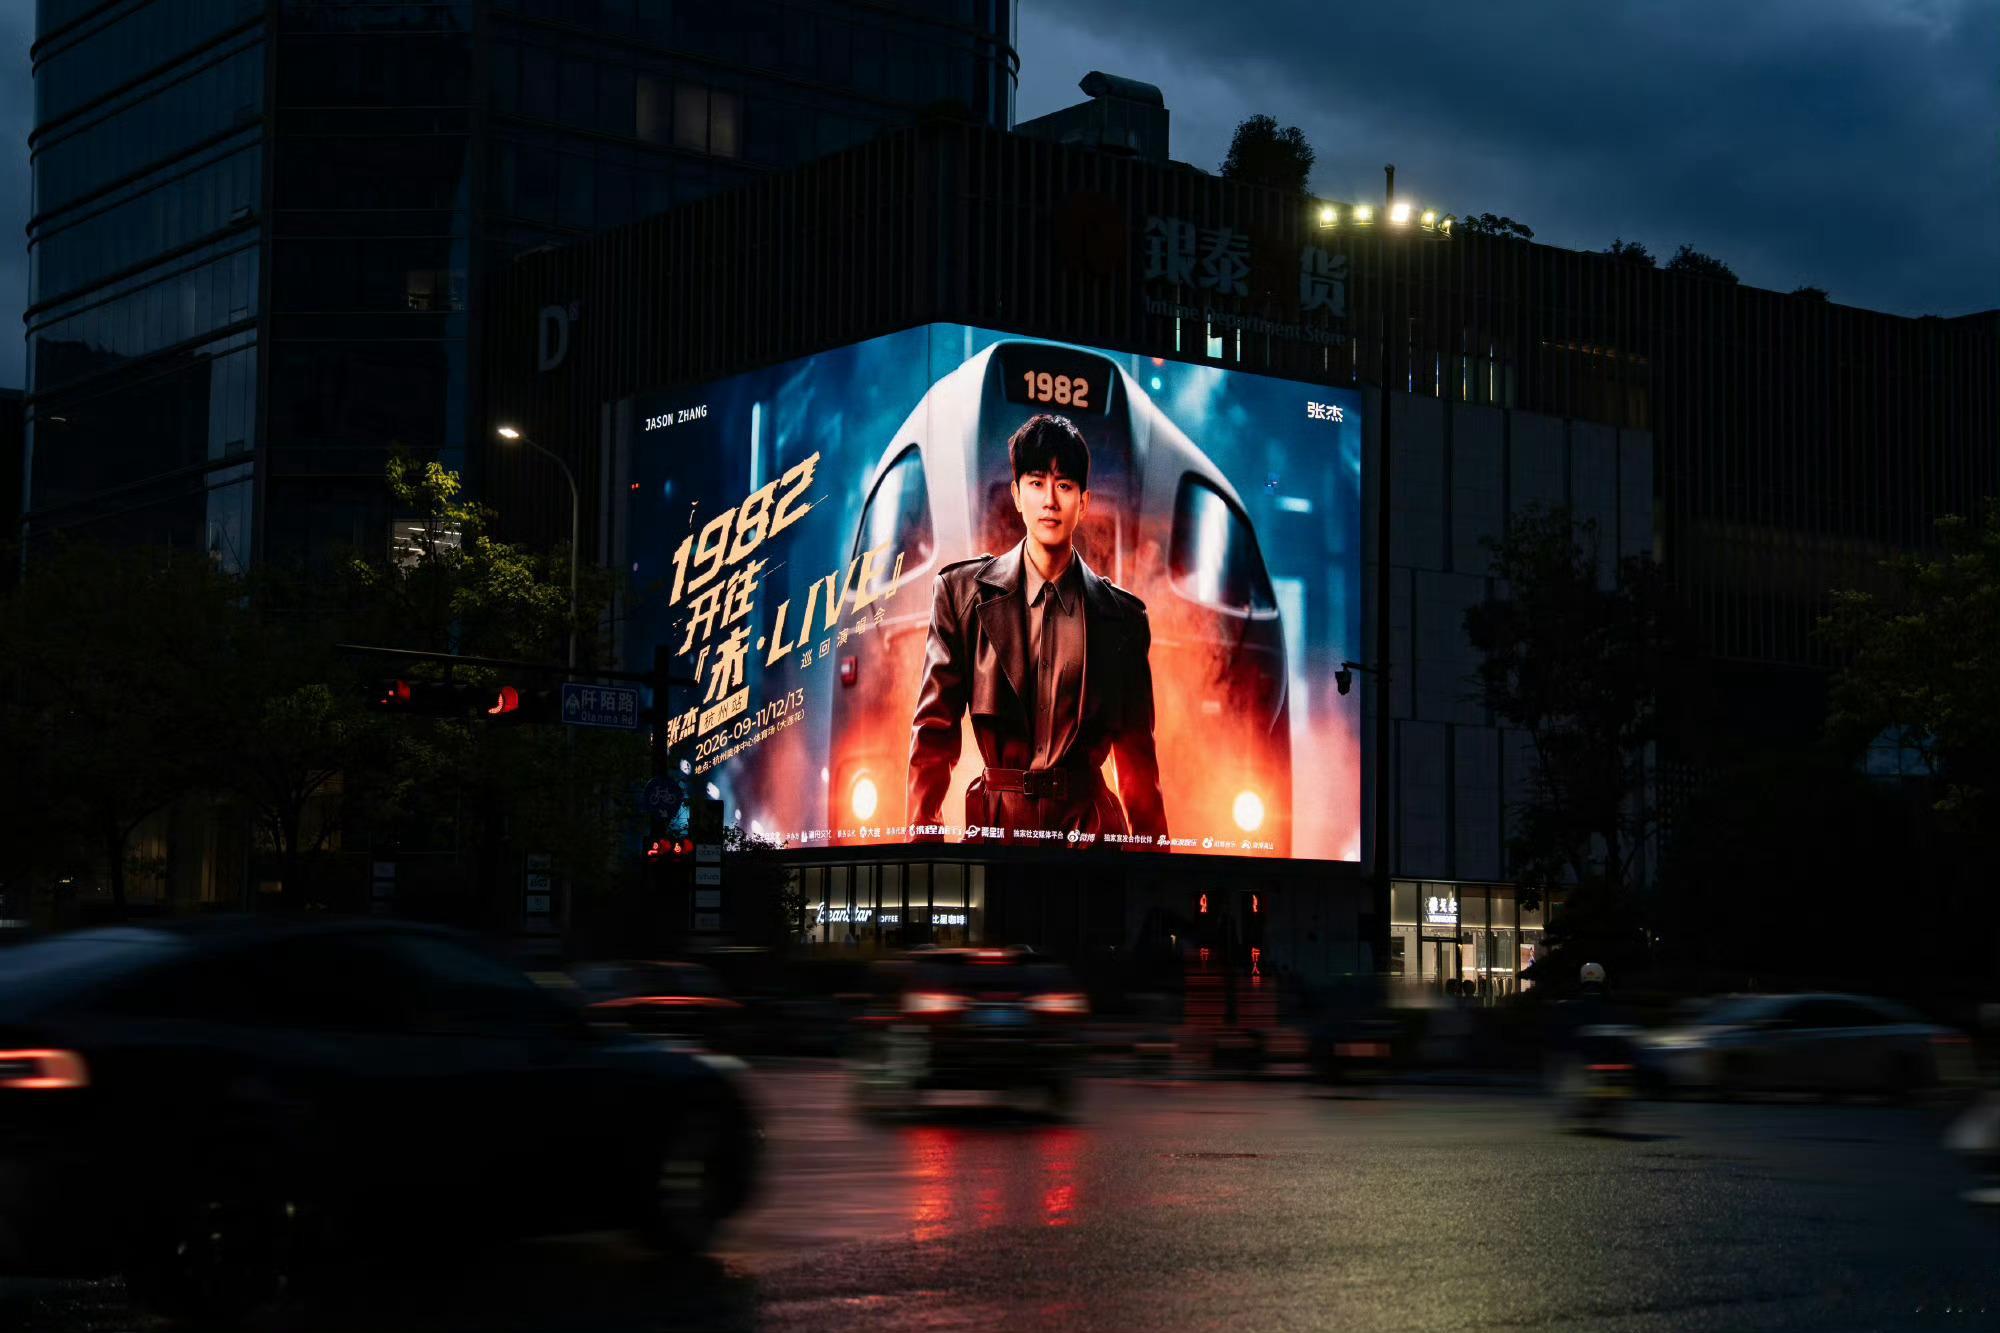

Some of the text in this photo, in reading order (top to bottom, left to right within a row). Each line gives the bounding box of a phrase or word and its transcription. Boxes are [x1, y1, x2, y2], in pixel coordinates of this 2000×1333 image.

[1024, 370, 1089, 409] 1982
[1307, 401, 1344, 422] 张杰
[645, 405, 707, 432] JASON ZHANG
[669, 452, 821, 607] 1982
[678, 557, 770, 656] 开往
[800, 607, 885, 669] 巡回演唱会
[581, 689, 634, 713] 阡陌路
[667, 694, 744, 747] 张杰 杭州站
[695, 688, 804, 762] 2026-09-11/12/13
